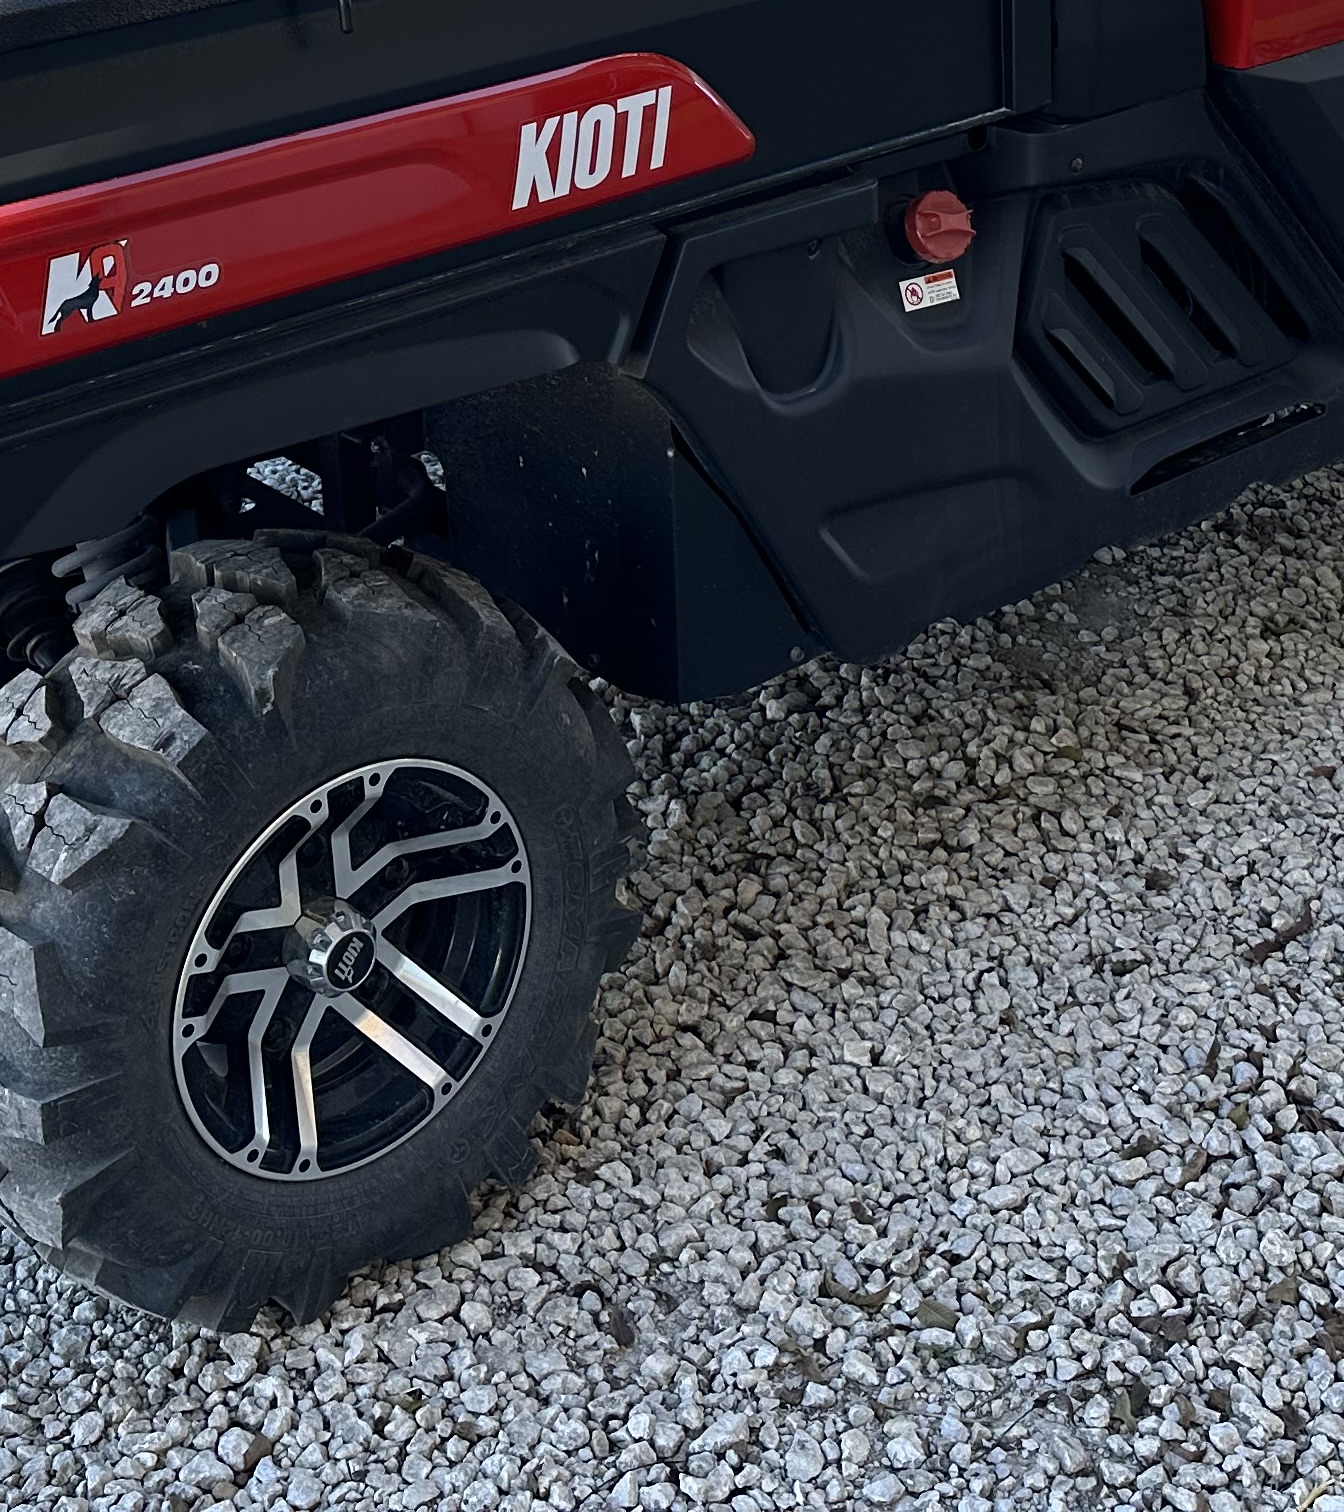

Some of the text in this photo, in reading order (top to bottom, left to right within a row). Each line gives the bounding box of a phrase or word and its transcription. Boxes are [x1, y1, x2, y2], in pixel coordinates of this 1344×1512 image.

[511, 85, 673, 211] KIOTI
[130, 263, 220, 309] 2400
[334, 936, 364, 984] KIOTI
